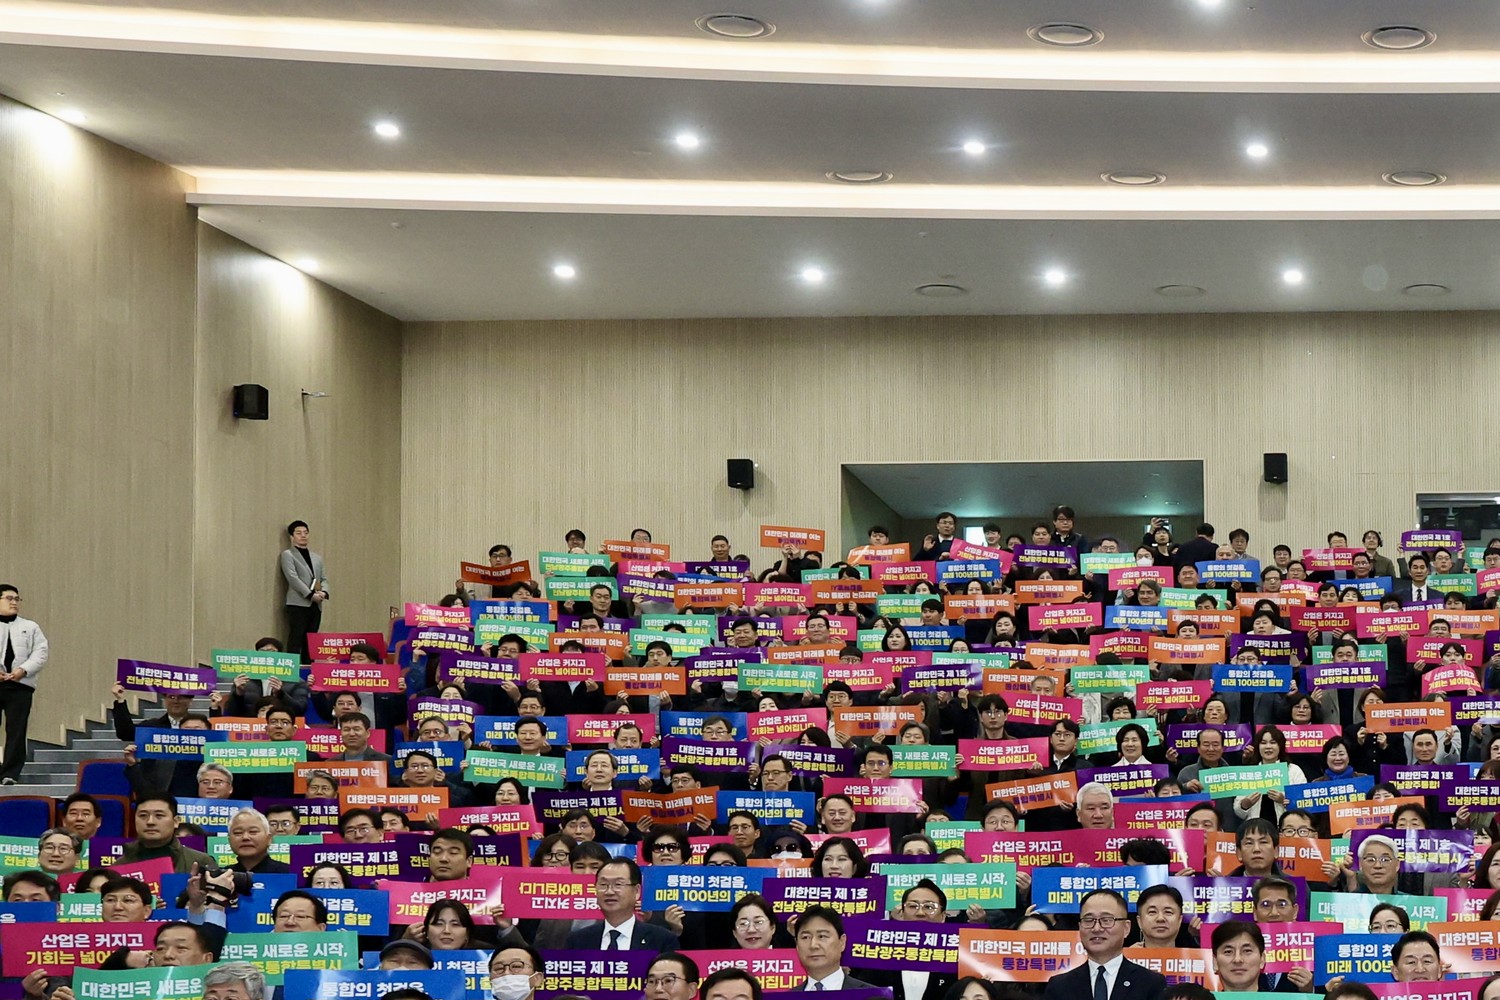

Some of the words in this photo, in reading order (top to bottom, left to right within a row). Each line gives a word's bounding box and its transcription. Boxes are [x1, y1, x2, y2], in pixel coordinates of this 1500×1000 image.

[979, 746, 1003, 755] 산업은
[1005, 745, 1029, 754] 커지고
[970, 755, 998, 764] 기회는
[1000, 754, 1037, 764] 넓어집니다
[1455, 786, 1487, 796] 대한민국
[992, 840, 1026, 852] 산업은
[1030, 840, 1062, 852] 커지고
[667, 874, 705, 888] 통합의
[708, 875, 748, 890] 첫걸음,
[938, 874, 977, 887] 새로운
[982, 872, 1007, 886] 시작,
[1060, 877, 1097, 889] 통합의
[1102, 877, 1140, 891] 첫걸음,
[656, 888, 679, 902] 미래
[679, 889, 731, 903] 100년의
[42, 933, 90, 948] 산업은
[96, 933, 143, 947] 커지고
[1440, 932, 1493, 946] 대한민국
[262, 944, 307, 959] 새로운
[313, 942, 348, 957] 시작,
[970, 941, 1026, 955] 대한민국
[1031, 942, 1070, 955] 미래를
[26, 950, 75, 965] 기회는
[1002, 956, 1070, 971] 통합특별시
[82, 980, 150, 997] 대한민국
